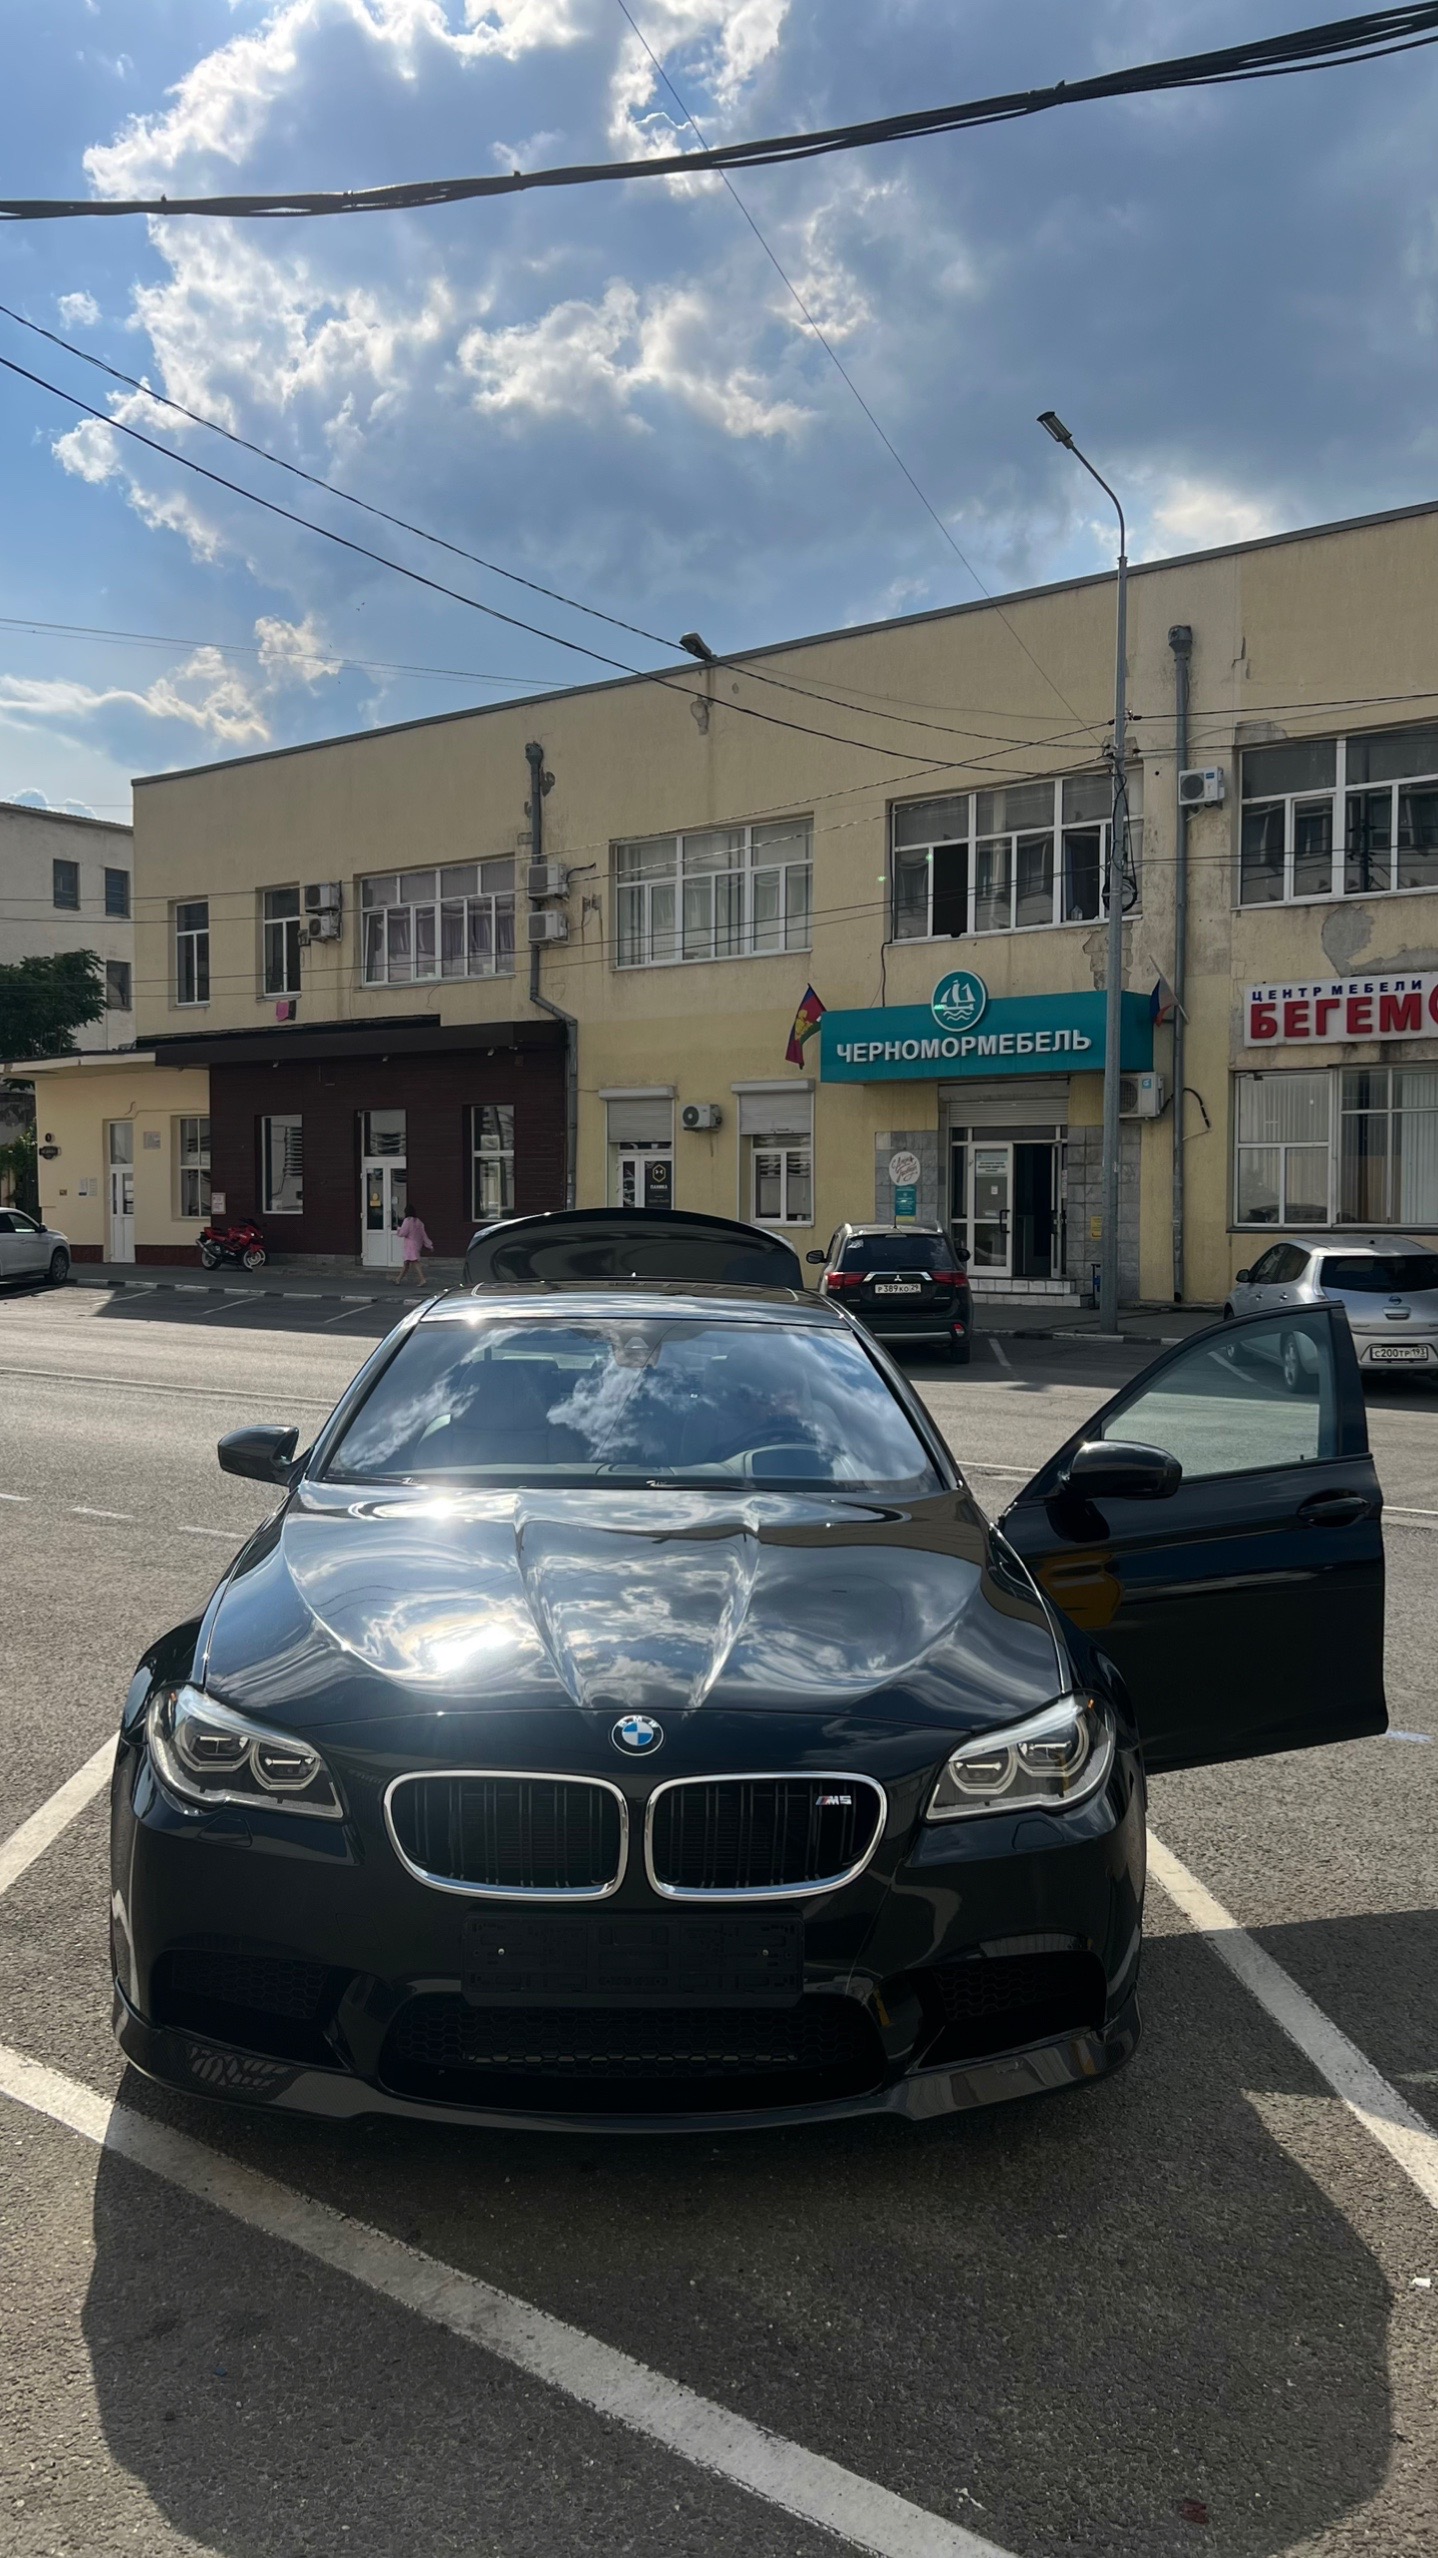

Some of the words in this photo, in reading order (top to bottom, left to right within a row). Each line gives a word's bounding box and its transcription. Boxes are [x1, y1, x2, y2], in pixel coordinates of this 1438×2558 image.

[1252, 986, 1322, 1002] ЦЕНТР
[1331, 979, 1422, 996] МЕБЕЛИ
[1250, 984, 1438, 1040] БЕГЕМ
[836, 1029, 1092, 1063] ЧЕРНОМОРМЕБЕЛЬ
[617, 1715, 660, 1728] BMW
[819, 1795, 852, 1805] M5
